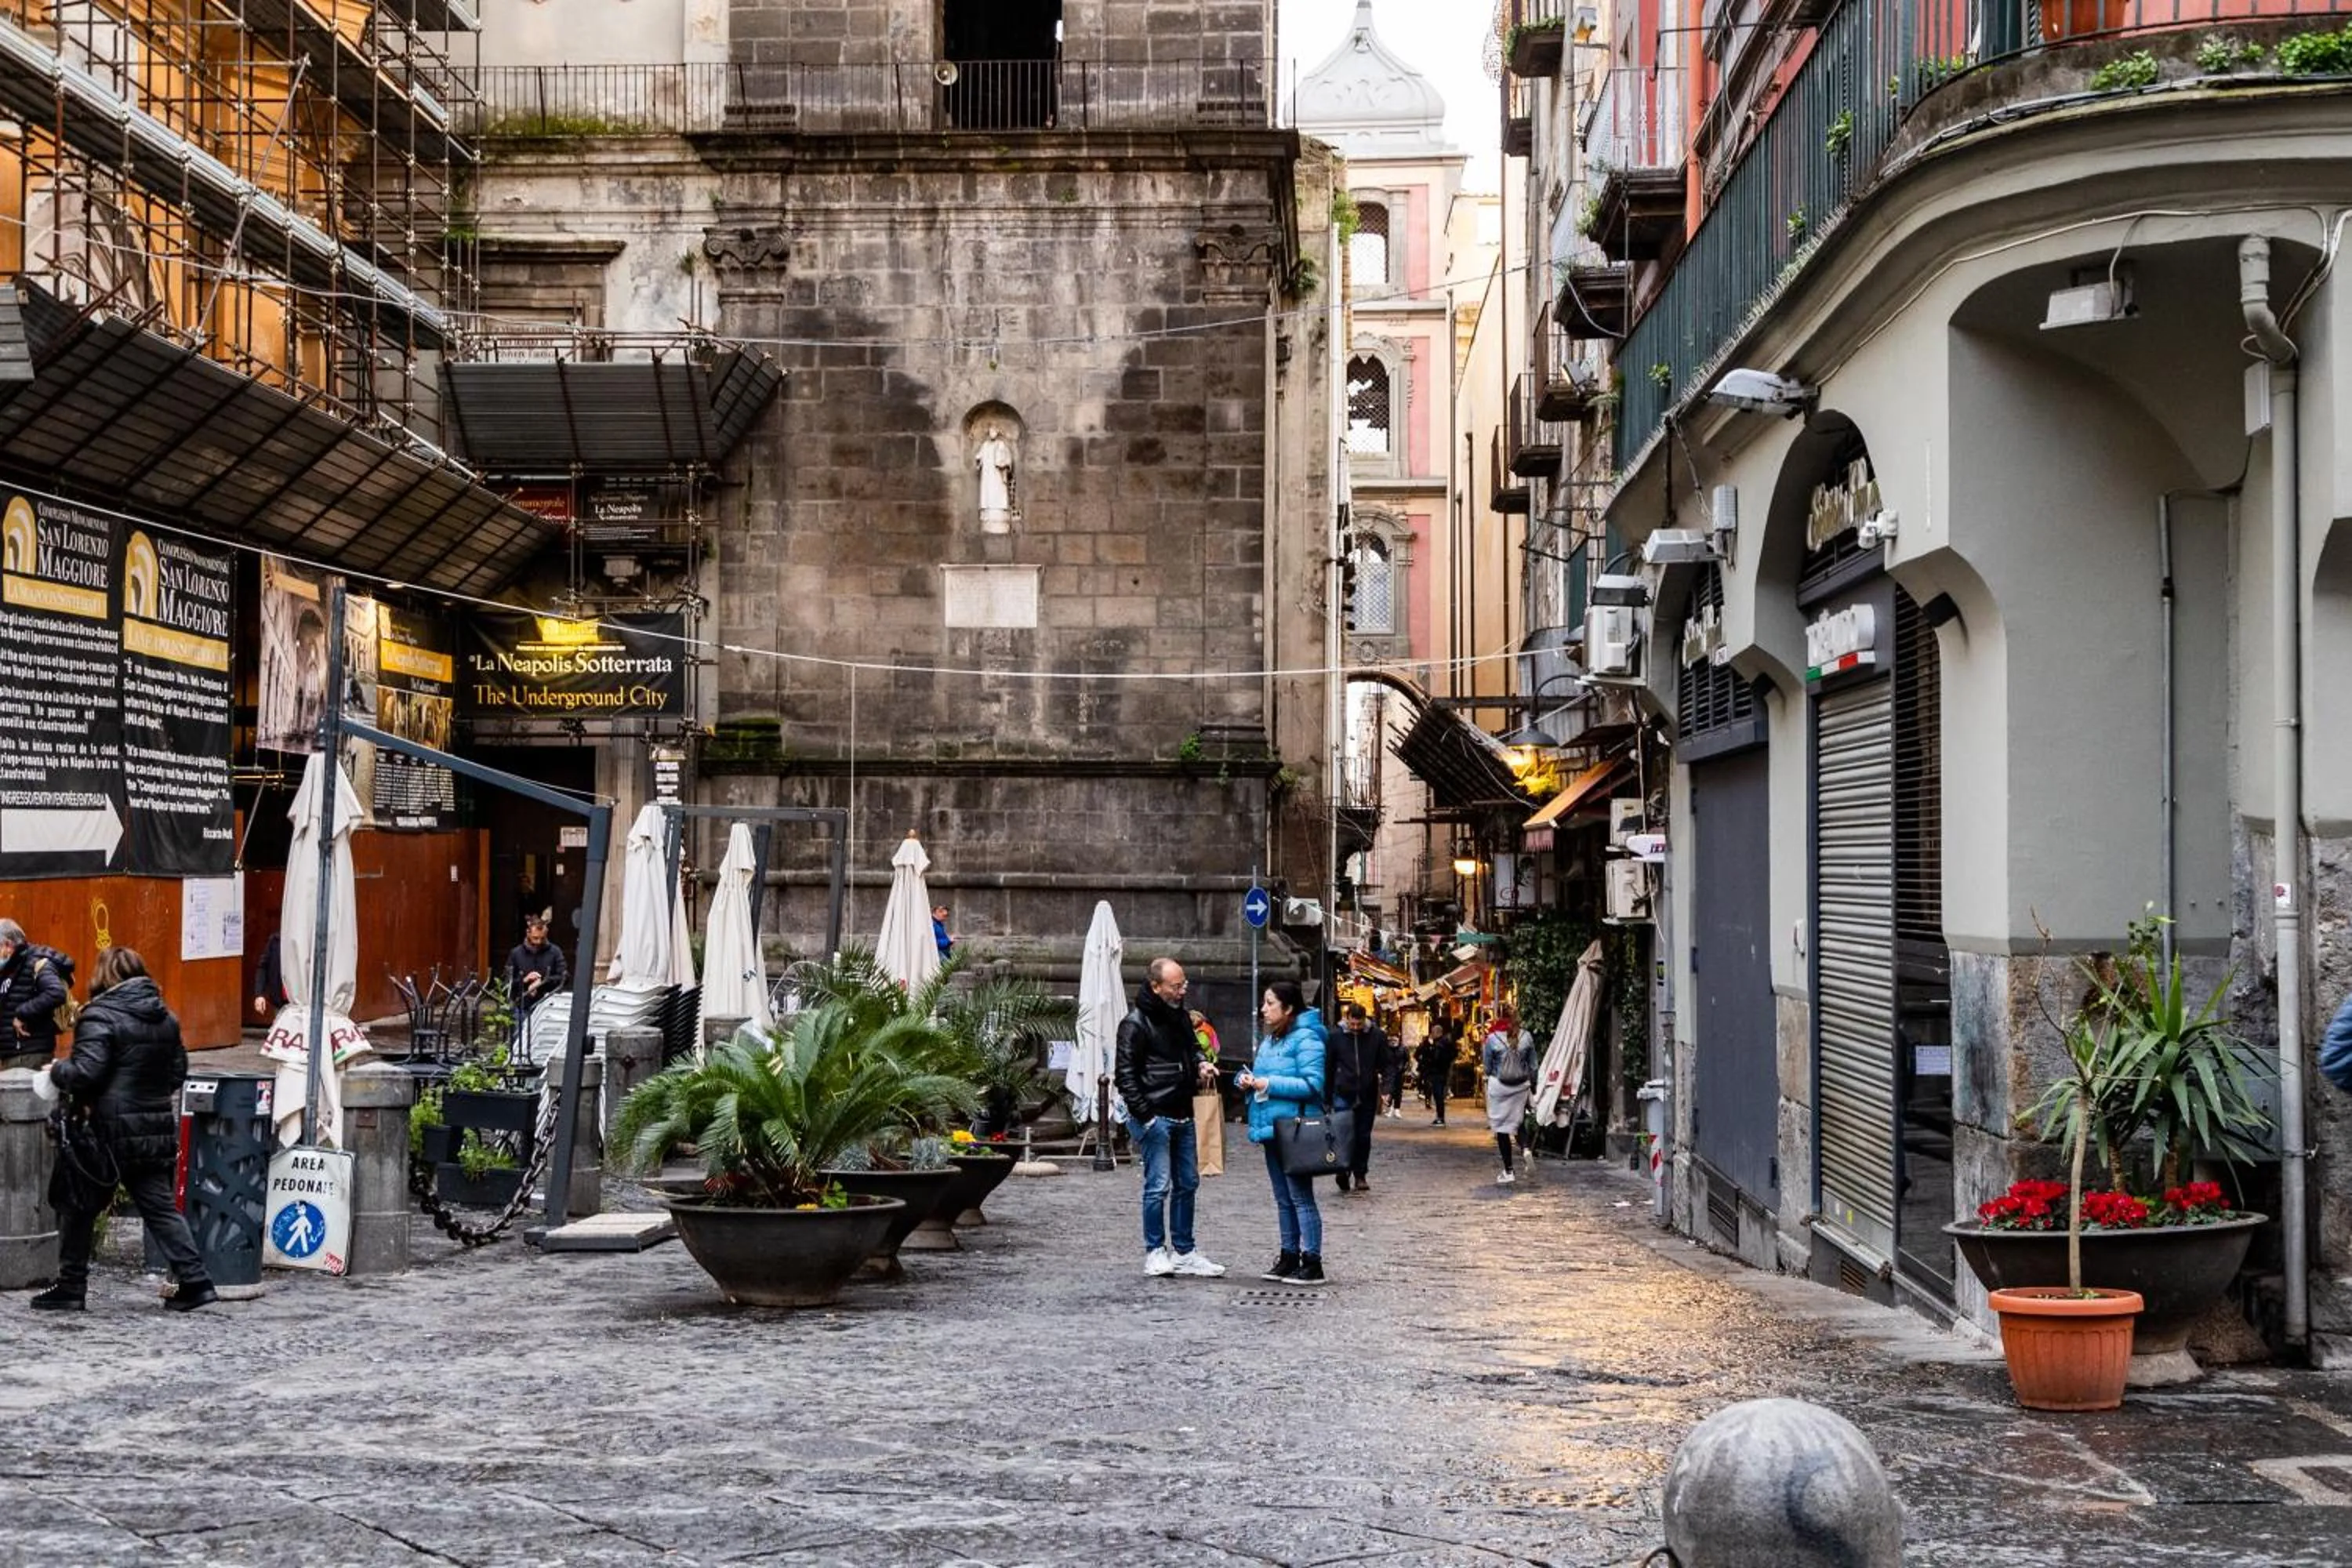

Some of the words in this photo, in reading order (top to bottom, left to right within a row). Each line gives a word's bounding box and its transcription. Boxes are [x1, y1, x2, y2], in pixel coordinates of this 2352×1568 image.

[38, 517, 62, 546] SAN
[63, 523, 109, 558] LORENZO
[37, 546, 109, 589] MAGGIORE
[160, 557, 183, 590] SAN
[185, 564, 230, 603] LORENZO
[158, 587, 228, 637] MAGGIORE
[474, 655, 495, 671] La
[496, 652, 572, 676] Neapolis
[574, 652, 672, 673] Sotterrata
[473, 684, 506, 706] The
[510, 684, 624, 710] Underground
[629, 684, 668, 711] City
[291, 1156, 326, 1171] AREA
